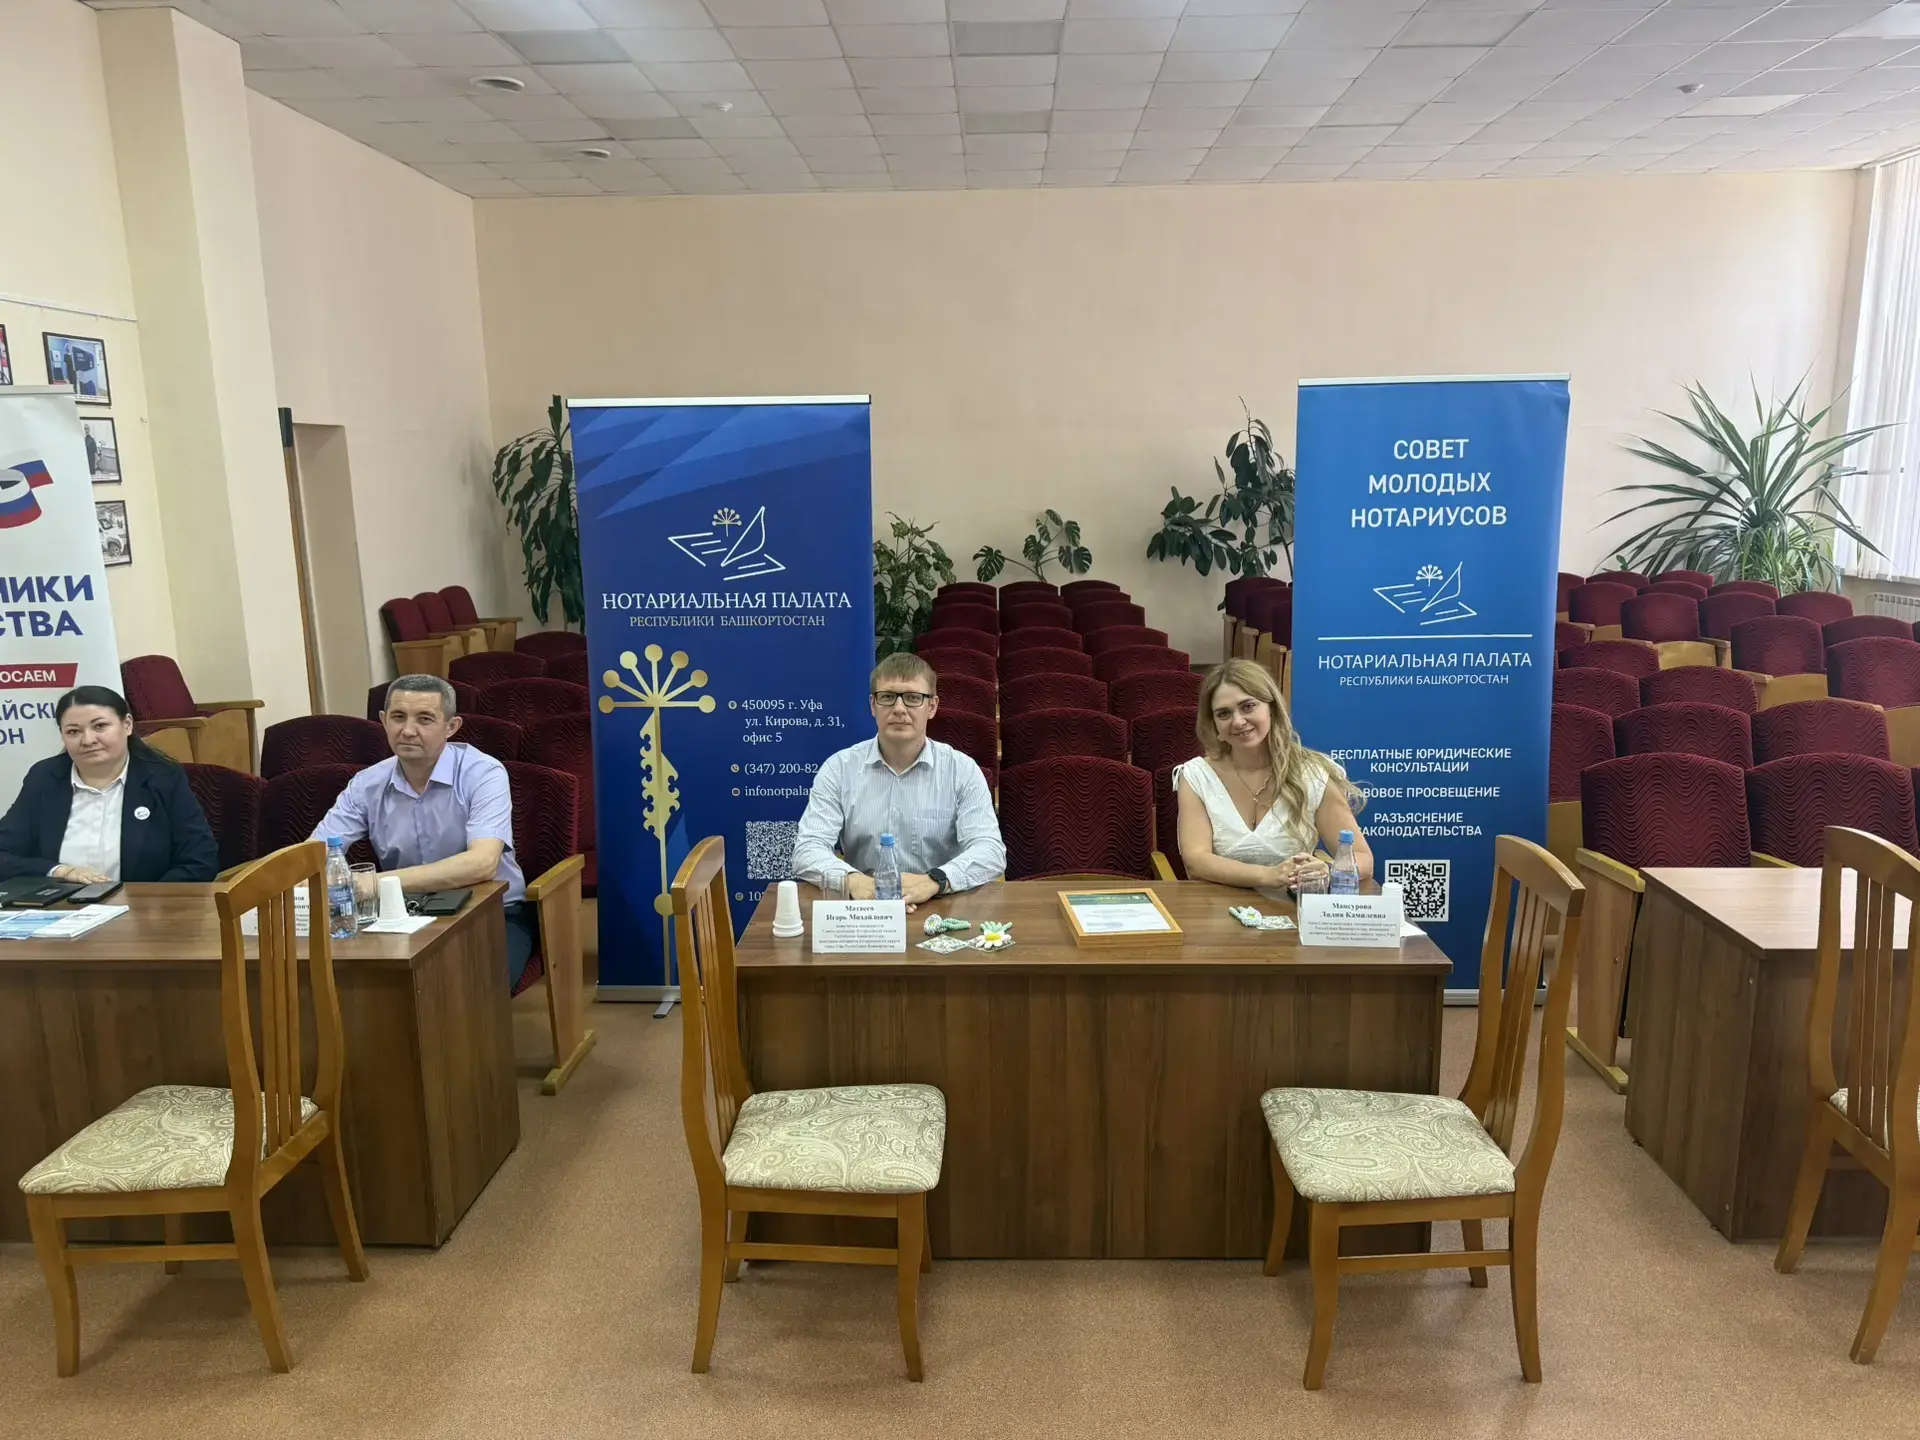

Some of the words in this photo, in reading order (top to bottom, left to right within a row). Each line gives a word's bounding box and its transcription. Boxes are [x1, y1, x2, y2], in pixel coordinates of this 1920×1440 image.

[1393, 439, 1469, 459] СОВЕТ
[1368, 472, 1491, 495] МОЛОДЫХ
[1351, 505, 1507, 528] НОТАРИУСОВ
[602, 592, 767, 609] НОТАРИАЛЬНАЯ
[771, 591, 852, 608] ПАЛАТА
[0, 610, 83, 637] ТВА
[629, 615, 715, 627] РЕСПУБЛИКИ
[720, 615, 825, 626] БАШКОРТОСТАН
[1318, 653, 1457, 669] НОТАРИАЛЬНАЯ
[1462, 652, 1532, 667] ПАЛАТА
[1339, 675, 1413, 686] РЕСПУБЛИКИ
[1416, 674, 1509, 685] БАШКОРТОСТАН
[0, 699, 57, 720] ЙСК
[741, 700, 785, 710] 450095
[788, 702, 798, 710] г.
[800, 699, 823, 713] Уфа
[745, 717, 762, 728] ул.
[765, 716, 812, 728] Кирова,
[814, 717, 825, 728] д.
[827, 716, 845, 728] 31,
[743, 732, 773, 745] офис
[775, 732, 783, 742] 5
[1330, 749, 1413, 760] БЕСПЛАТНЫЕ
[1416, 748, 1512, 760] ЮРИДИЧЕСКИЕ
[744, 763, 775, 775] (347)
[1370, 762, 1469, 773] КОНСУЛЬТАЦИИ
[1406, 787, 1500, 798] ПРОСВЕЩЕНИЕ
[1374, 812, 1463, 823] РАЗЪЯСНЕНИЕ
[1360, 826, 1482, 837] АКОНОДАТЕЛЬСТВА
